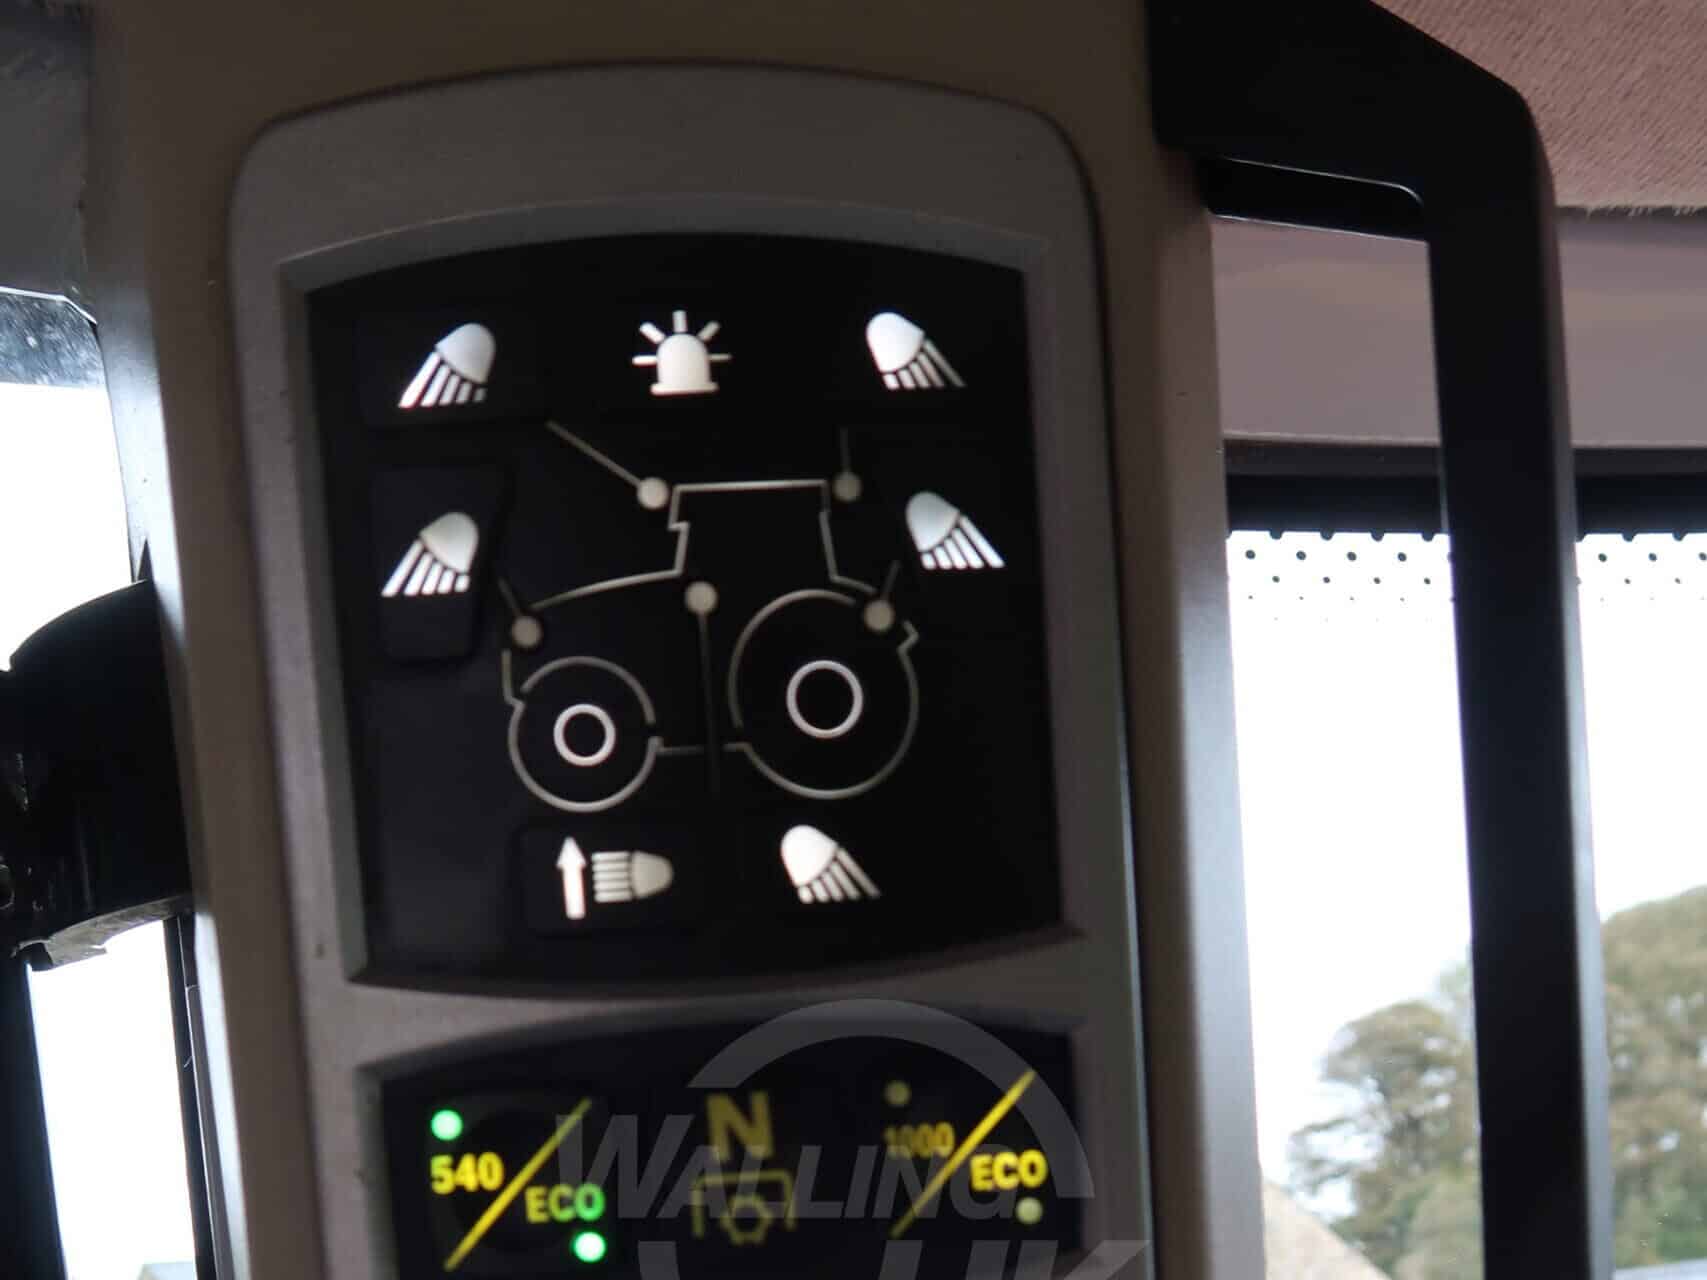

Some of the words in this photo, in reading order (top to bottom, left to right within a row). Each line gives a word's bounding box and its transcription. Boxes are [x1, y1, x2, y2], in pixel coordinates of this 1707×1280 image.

[705, 1092, 774, 1163] N
[884, 1122, 954, 1160] 1000
[430, 1152, 504, 1194] 540
[969, 1149, 1048, 1191] ECO
[525, 1184, 604, 1223] ECO
